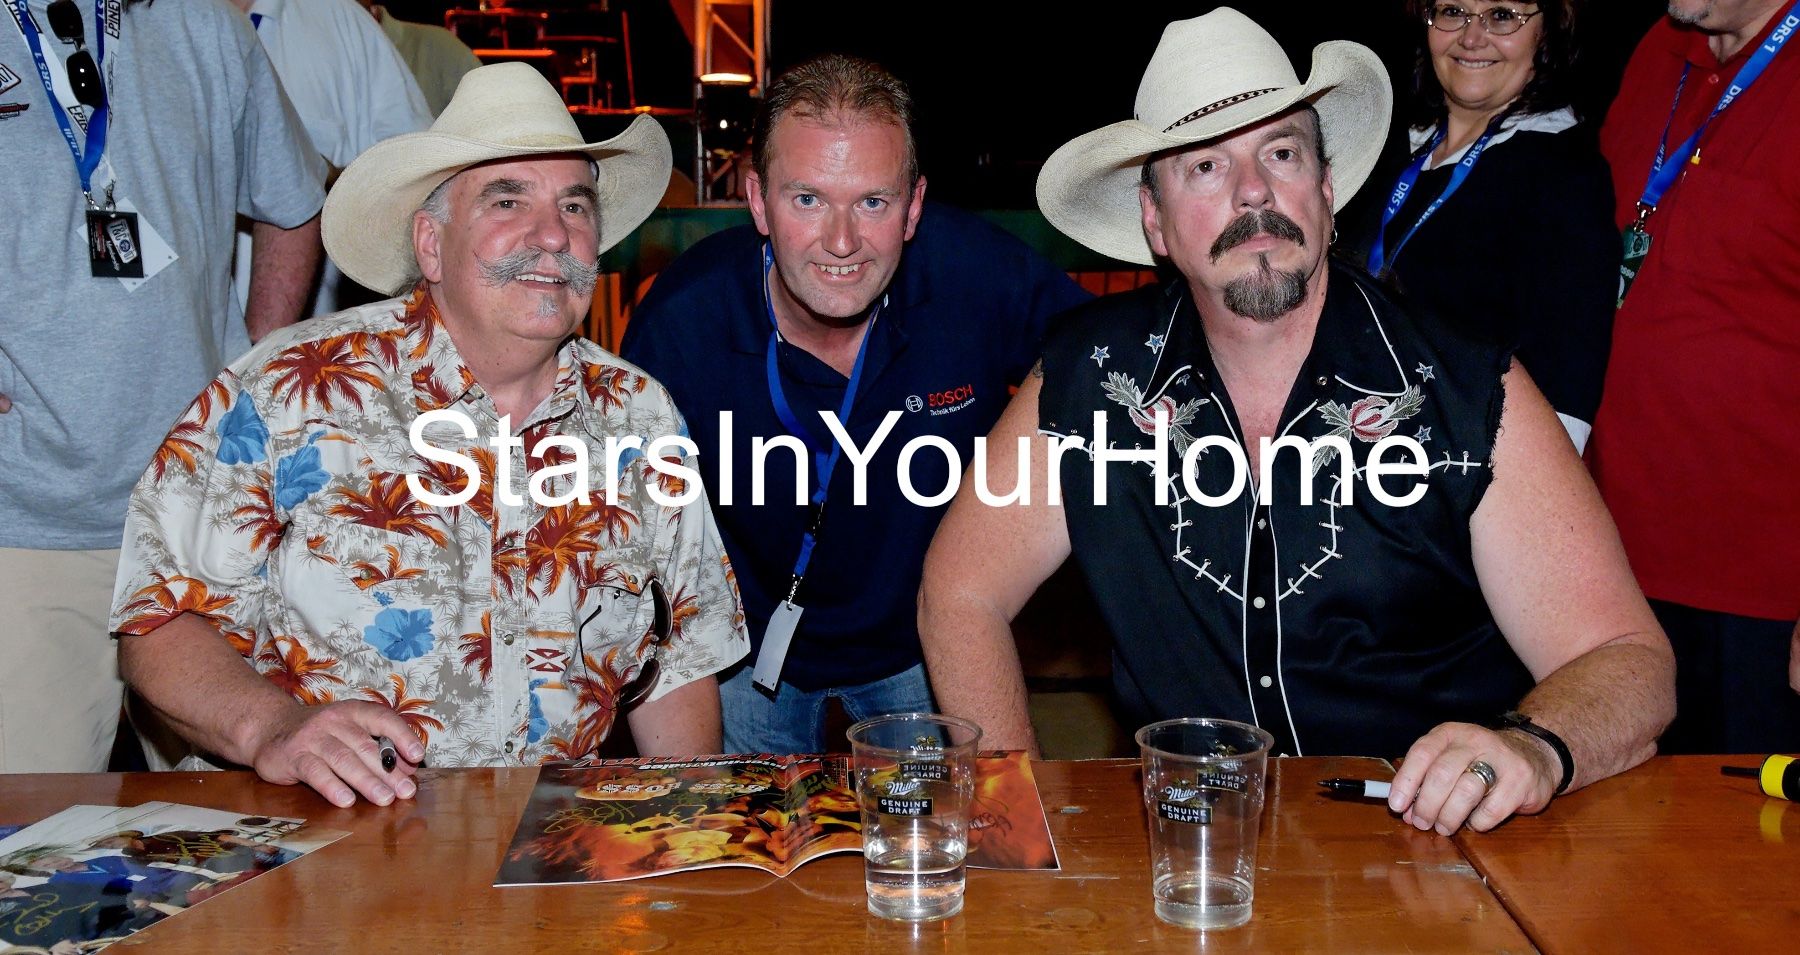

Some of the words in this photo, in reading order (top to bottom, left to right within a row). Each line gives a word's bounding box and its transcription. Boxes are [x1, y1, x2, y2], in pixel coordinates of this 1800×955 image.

[1772, 14, 1800, 44] DRS
[34, 51, 41, 59] 1
[1763, 44, 1777, 54] 1
[38, 62, 53, 92] DRS
[1462, 142, 1483, 168] DRS
[1391, 181, 1410, 207] DRS
[928, 384, 974, 407] BOSCH
[885, 781, 920, 796] Miller
[1165, 787, 1199, 802] Miller
[881, 799, 928, 808] GENUINE
[888, 806, 920, 814] DRAFT
[1161, 803, 1207, 817] GENUINE
[1167, 813, 1200, 823] DRAFT
